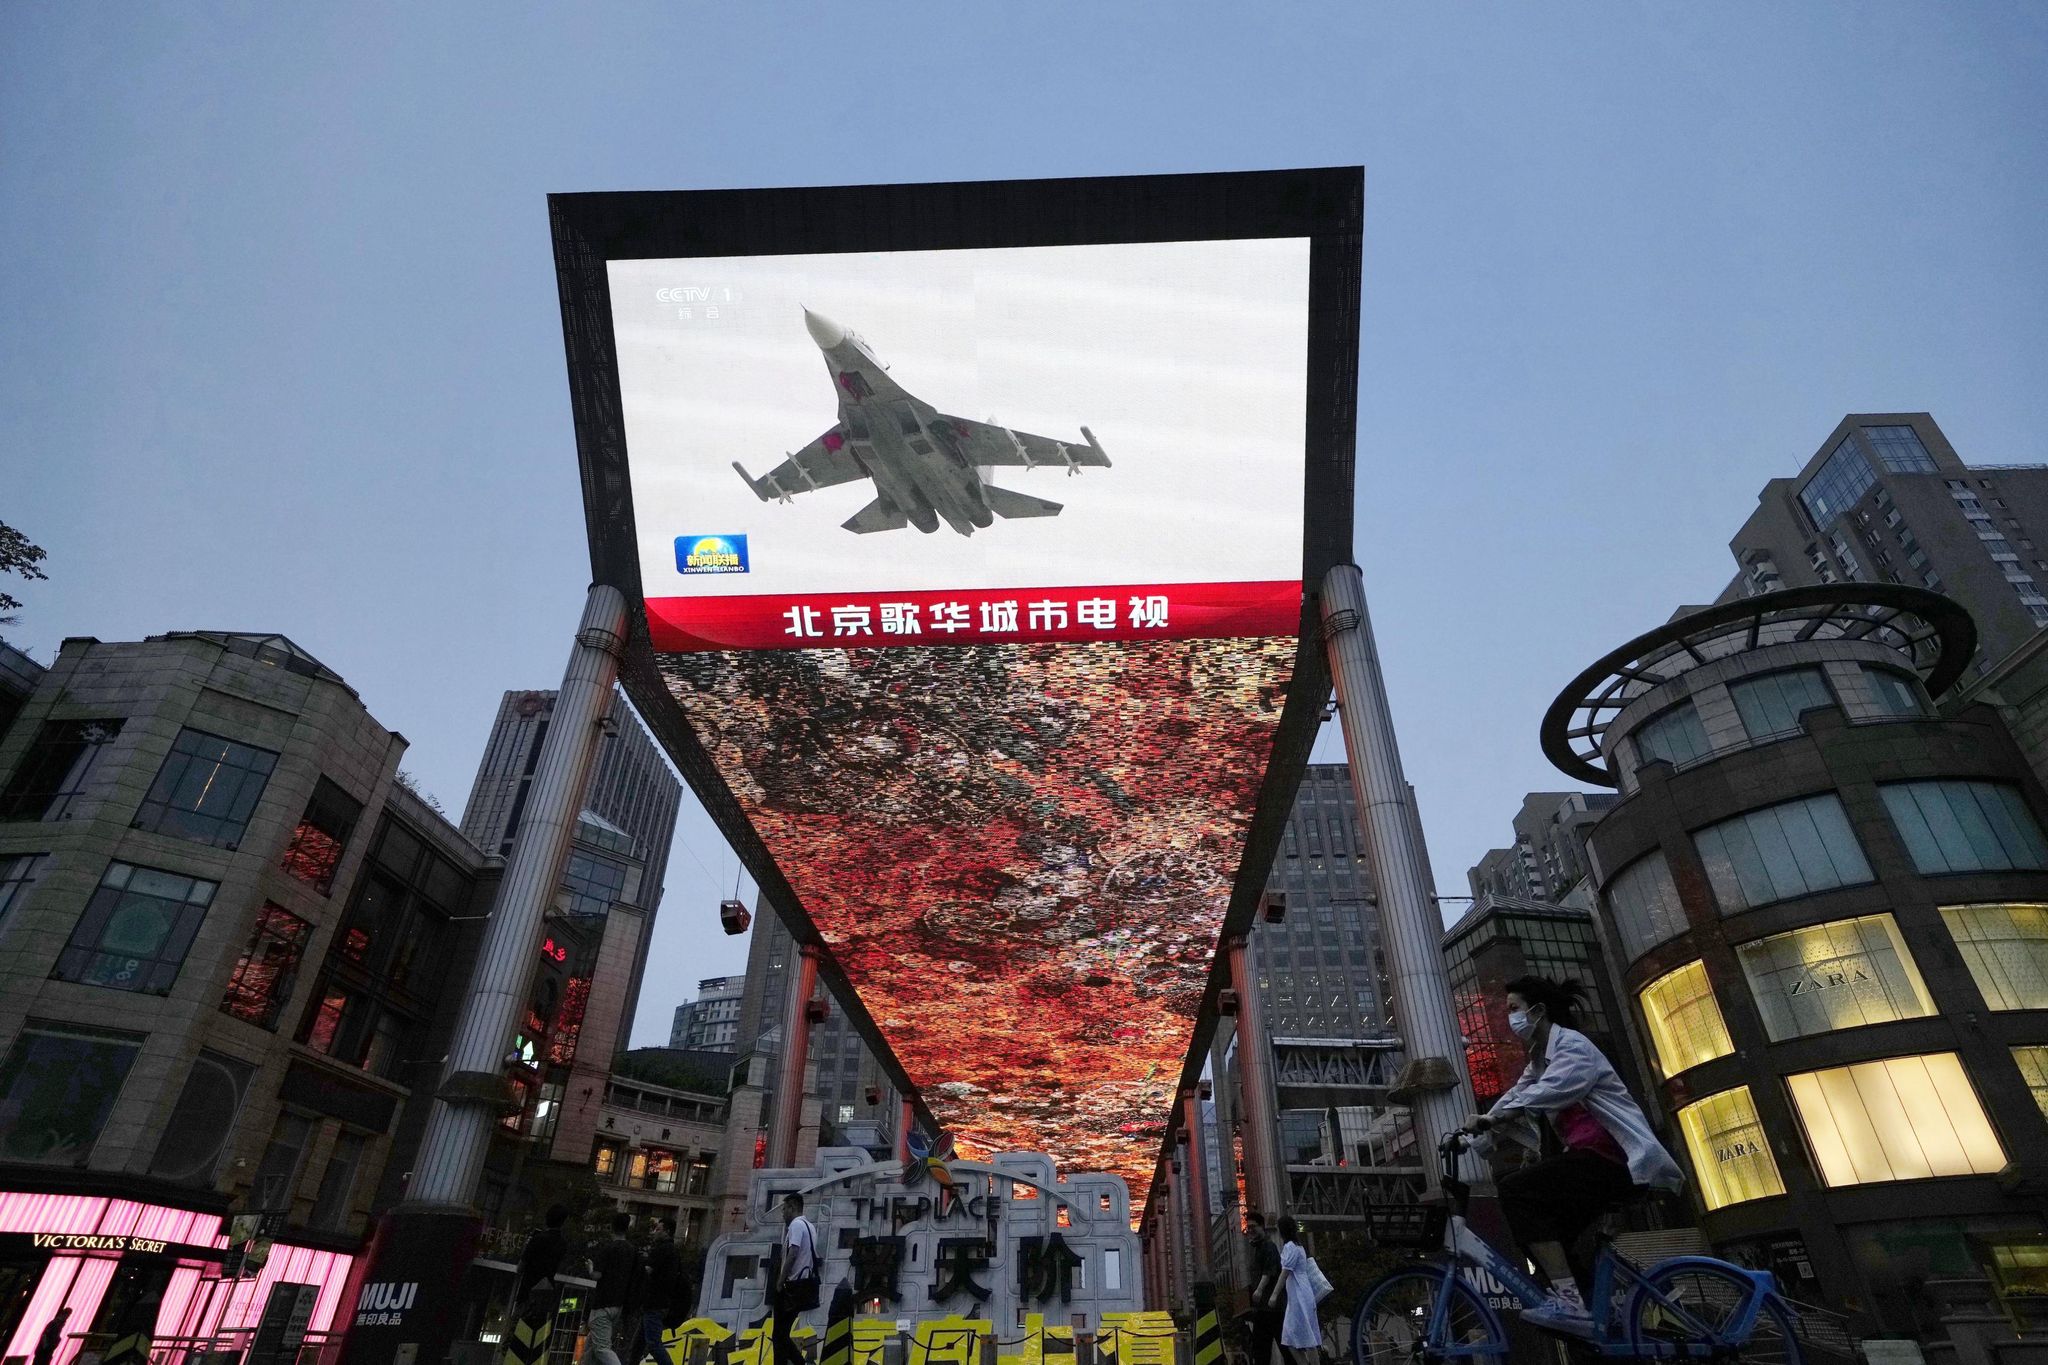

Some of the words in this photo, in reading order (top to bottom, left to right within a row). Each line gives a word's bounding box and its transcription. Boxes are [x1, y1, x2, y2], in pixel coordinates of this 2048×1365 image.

[656, 287, 711, 302] CCTV
[723, 288, 731, 302] 1
[783, 595, 1169, 638] 北京歌华城市电视
[1788, 970, 1871, 996] ZARA
[1716, 1141, 1761, 1163] ZARA
[851, 1196, 906, 1220] THE
[917, 1194, 1001, 1220] PLACE
[32, 1233, 126, 1250] VICTORIA'S
[129, 1237, 168, 1254] SECRET
[357, 1282, 419, 1310] MUJI
[1487, 1296, 1523, 1311] 印良品
